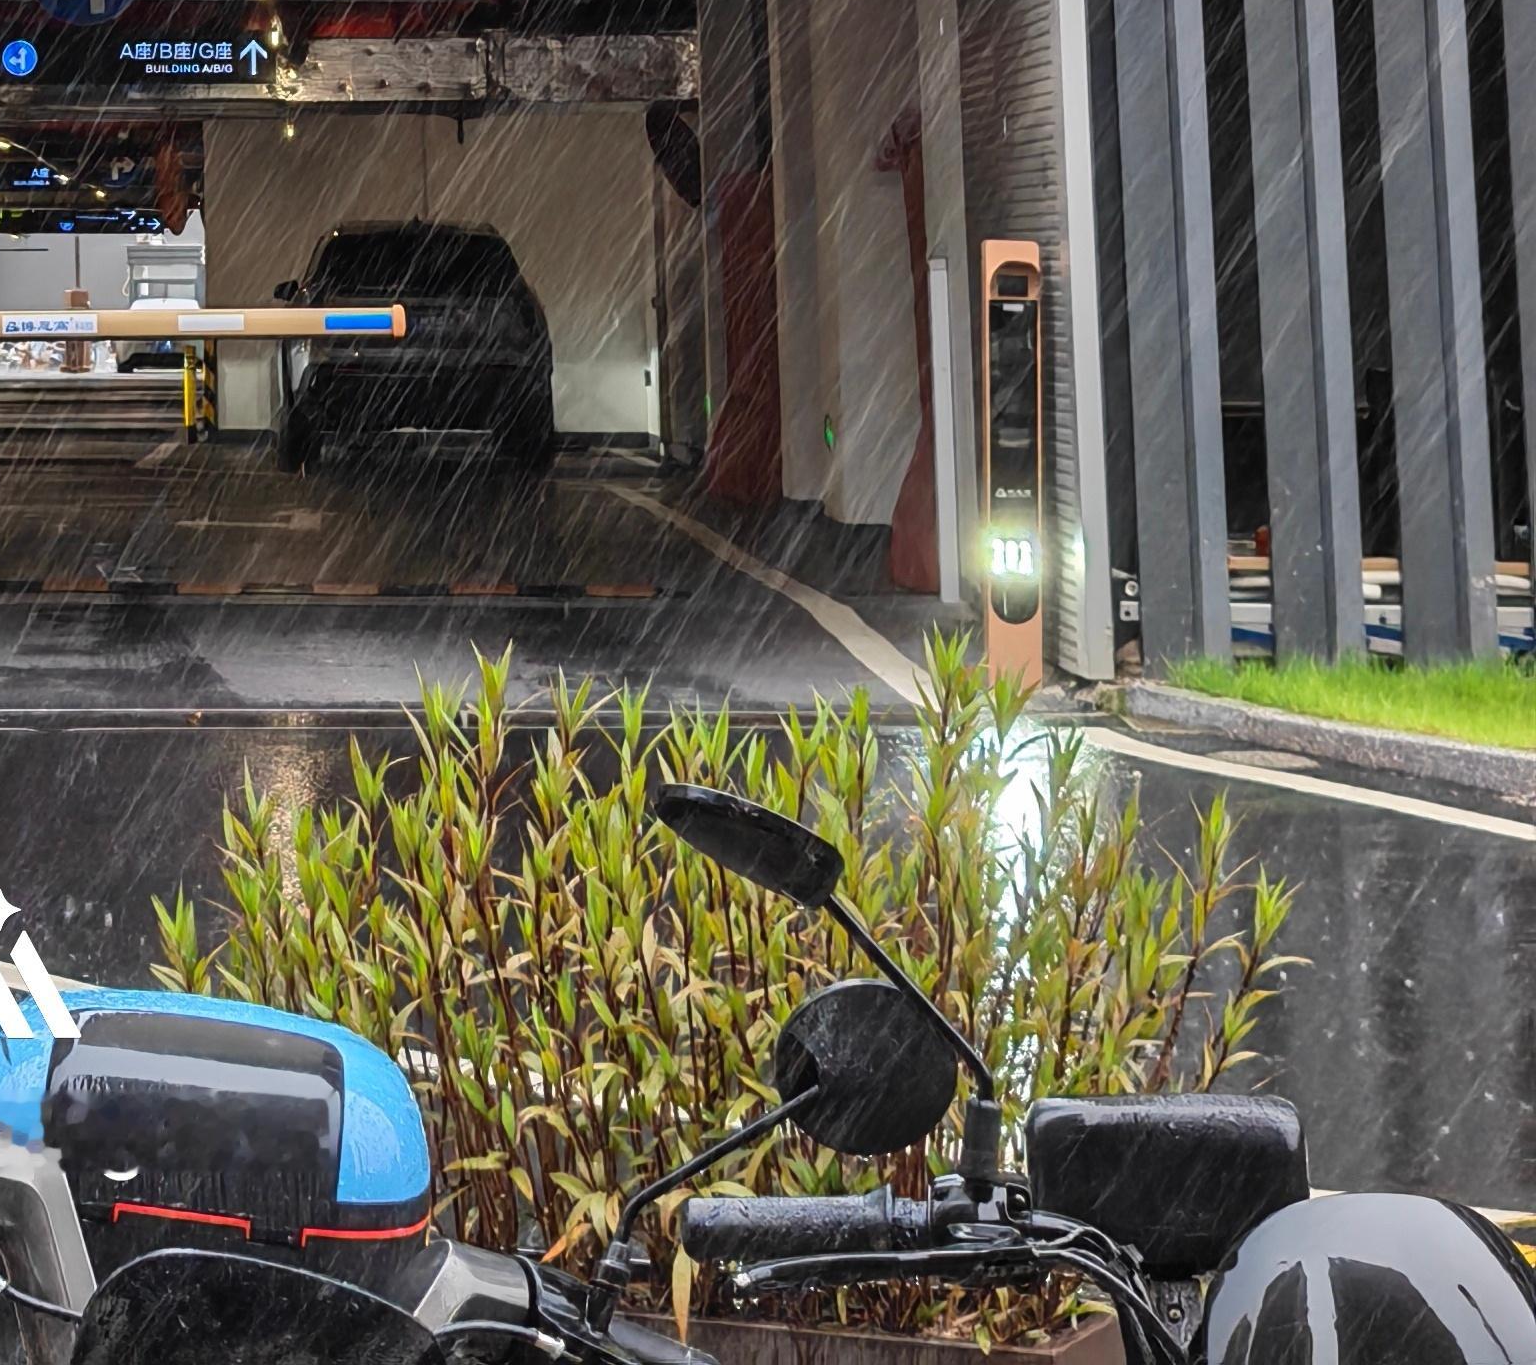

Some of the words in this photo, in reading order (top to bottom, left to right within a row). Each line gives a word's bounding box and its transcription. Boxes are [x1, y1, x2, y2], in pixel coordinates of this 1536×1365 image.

[119, 41, 233, 60] A座/B座/G座
[145, 64, 200, 74] BUILDING
